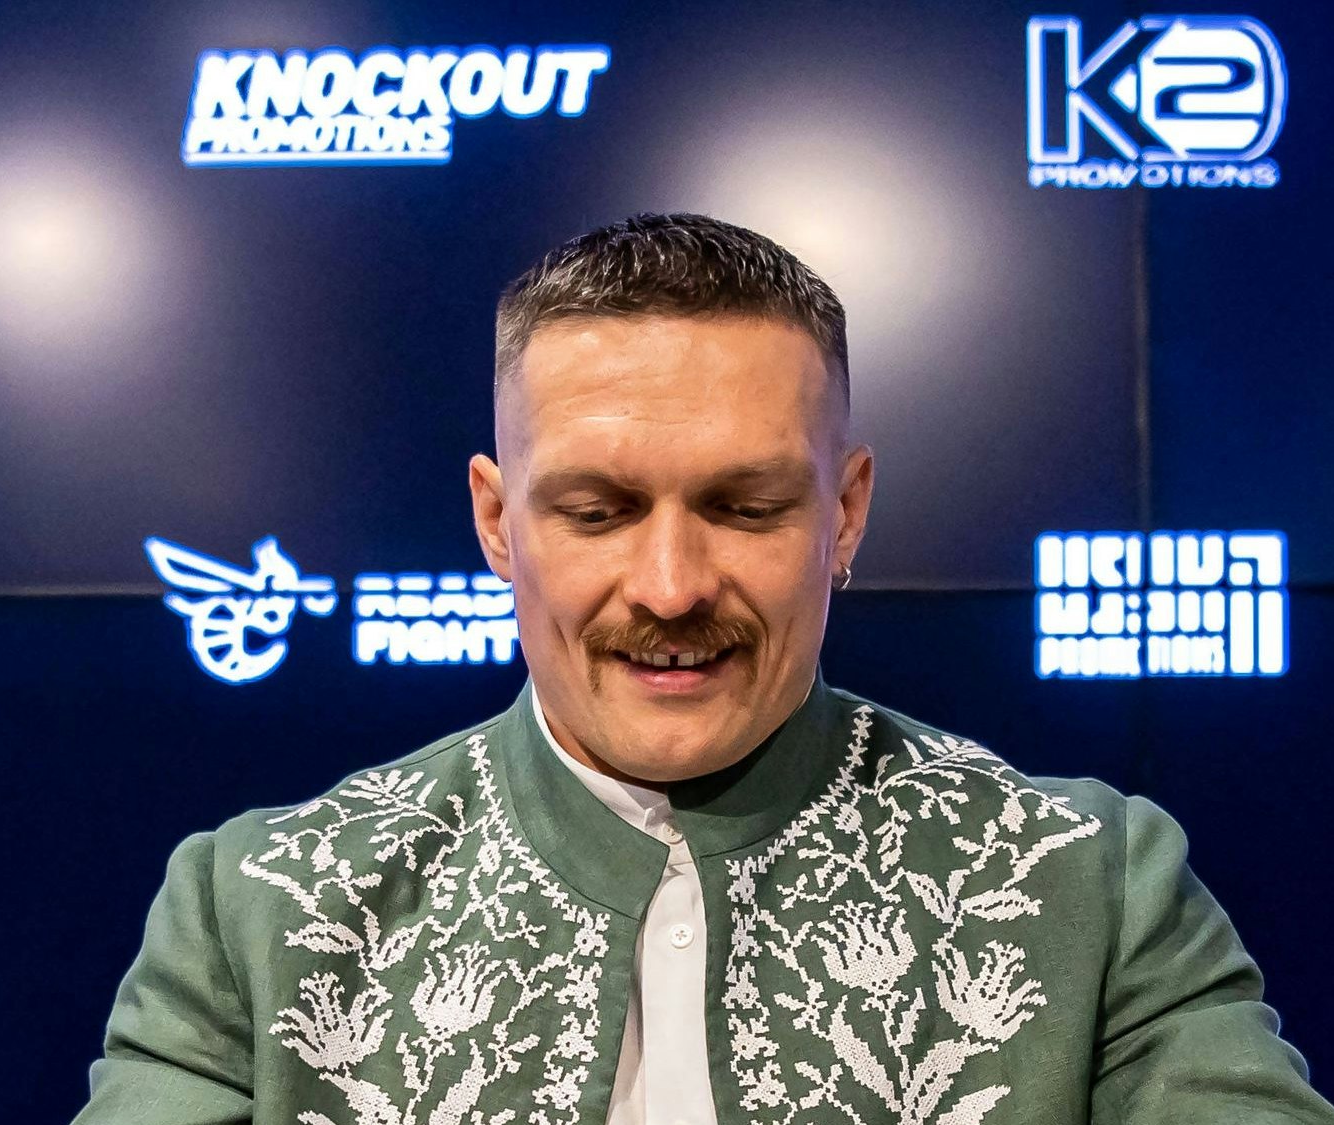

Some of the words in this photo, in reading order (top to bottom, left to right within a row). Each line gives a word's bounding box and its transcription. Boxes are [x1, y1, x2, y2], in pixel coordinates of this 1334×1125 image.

[190, 44, 612, 119] KNOCKOUT
[184, 115, 455, 154] PROMOTIONS
[352, 571, 517, 618] READ
[352, 617, 520, 665] FIGHT
